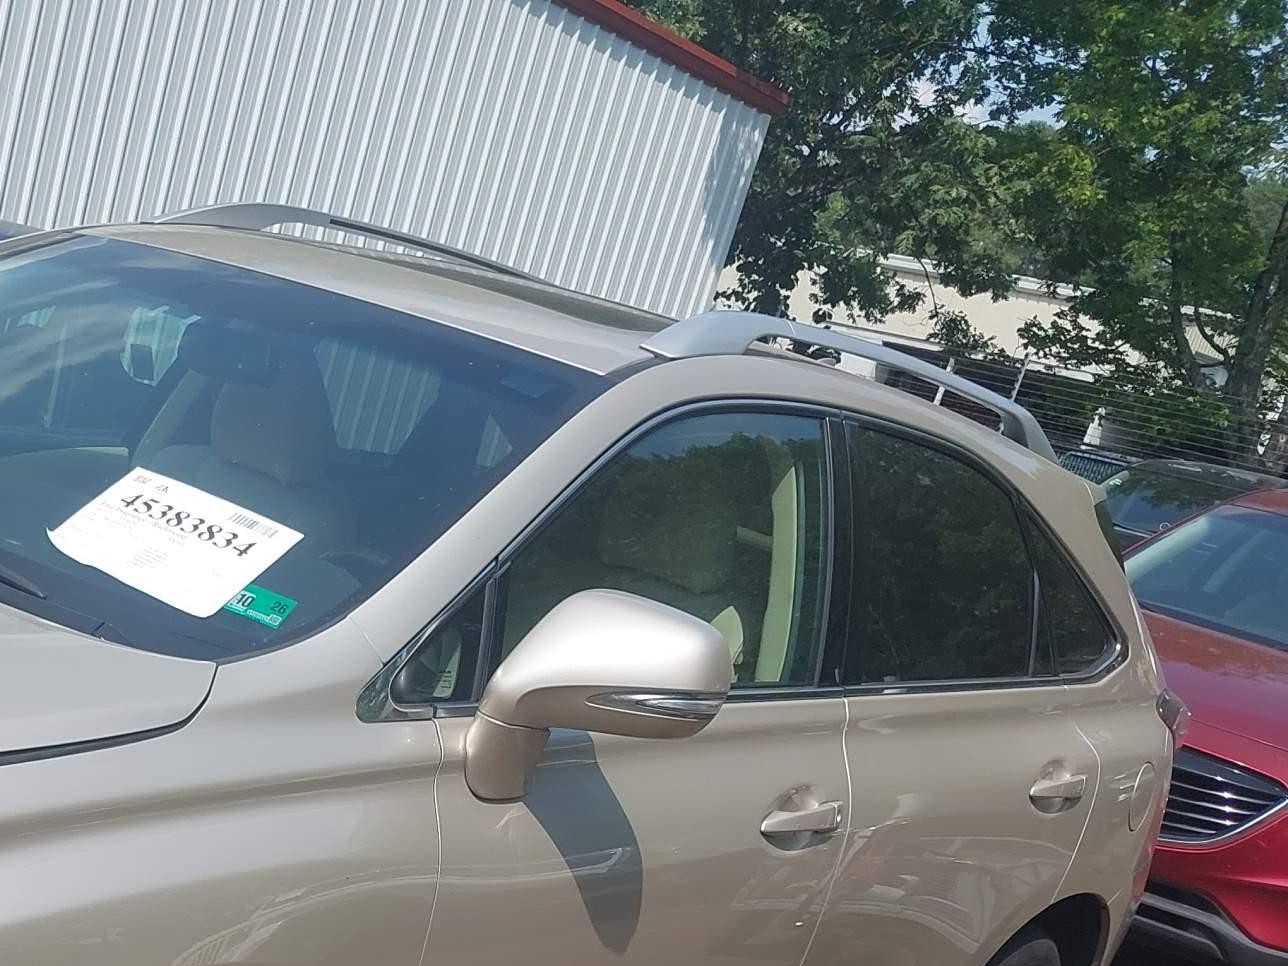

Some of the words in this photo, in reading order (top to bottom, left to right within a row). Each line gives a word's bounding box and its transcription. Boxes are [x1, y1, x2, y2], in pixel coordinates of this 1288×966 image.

[120, 494, 257, 557] 45383834
[236, 593, 255, 608] 10
[271, 601, 289, 614] 26
